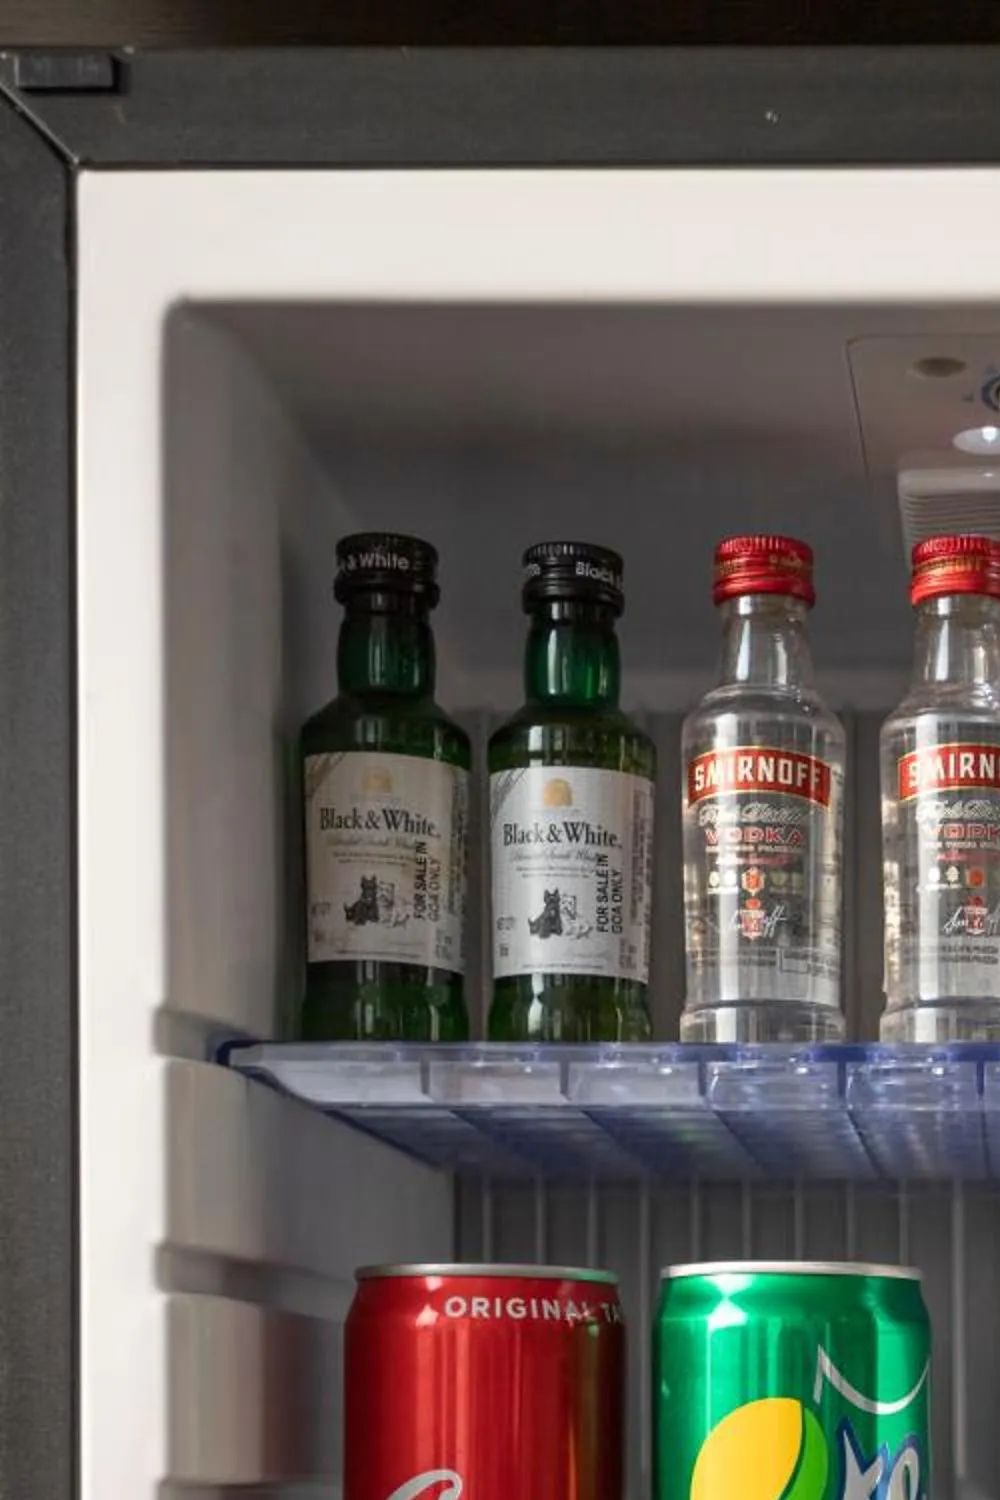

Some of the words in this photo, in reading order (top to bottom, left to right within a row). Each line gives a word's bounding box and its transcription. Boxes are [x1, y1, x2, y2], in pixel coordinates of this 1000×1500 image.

[359, 551, 410, 571] White
[694, 756, 821, 792] SMIRNOFF
[414, 858, 427, 891] SALE
[596, 870, 609, 904] SALE
[414, 894, 427, 921] FOR
[596, 907, 609, 933] FOR
[611, 906, 623, 934] GOA
[444, 1296, 592, 1323] ORIGINAL
